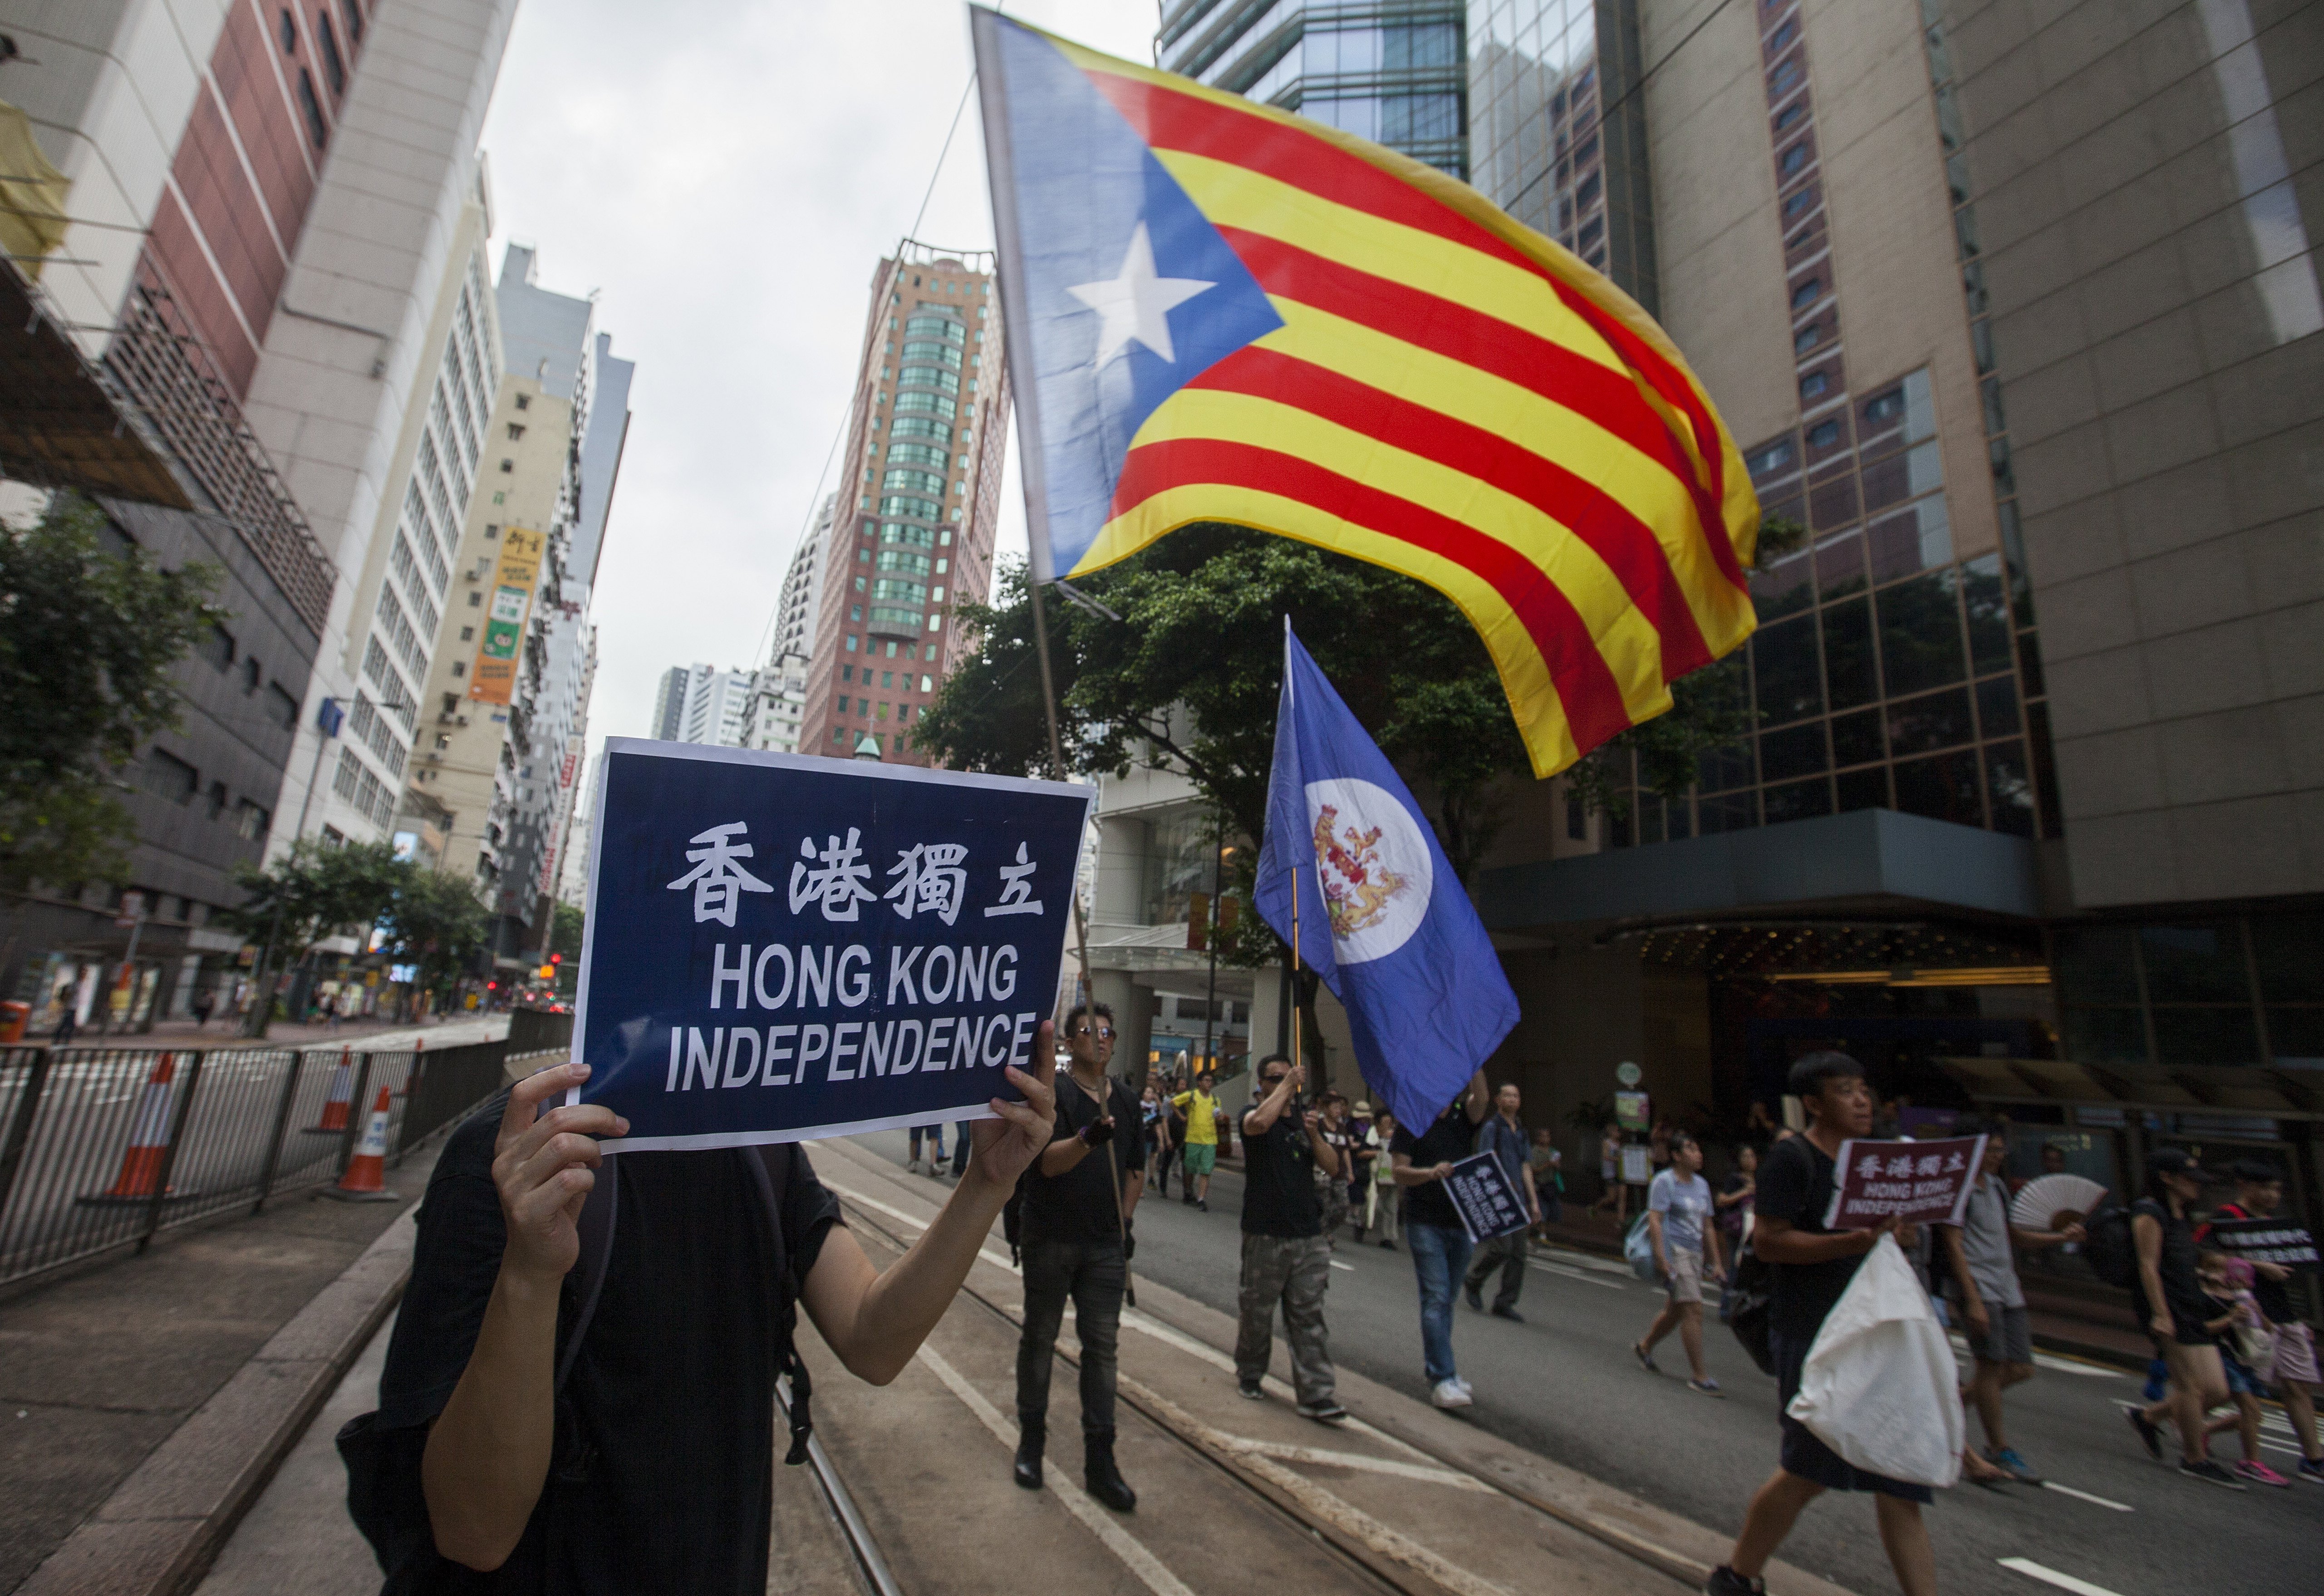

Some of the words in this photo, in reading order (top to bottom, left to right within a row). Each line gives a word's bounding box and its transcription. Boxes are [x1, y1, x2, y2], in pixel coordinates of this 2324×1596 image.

[667, 821, 1043, 927] 香港獨立
[711, 944, 871, 1010] HONG
[888, 945, 1017, 1005] KONG
[667, 1013, 1036, 1092] INDEPENDENCE
[1863, 1182, 1911, 1199] HONG
